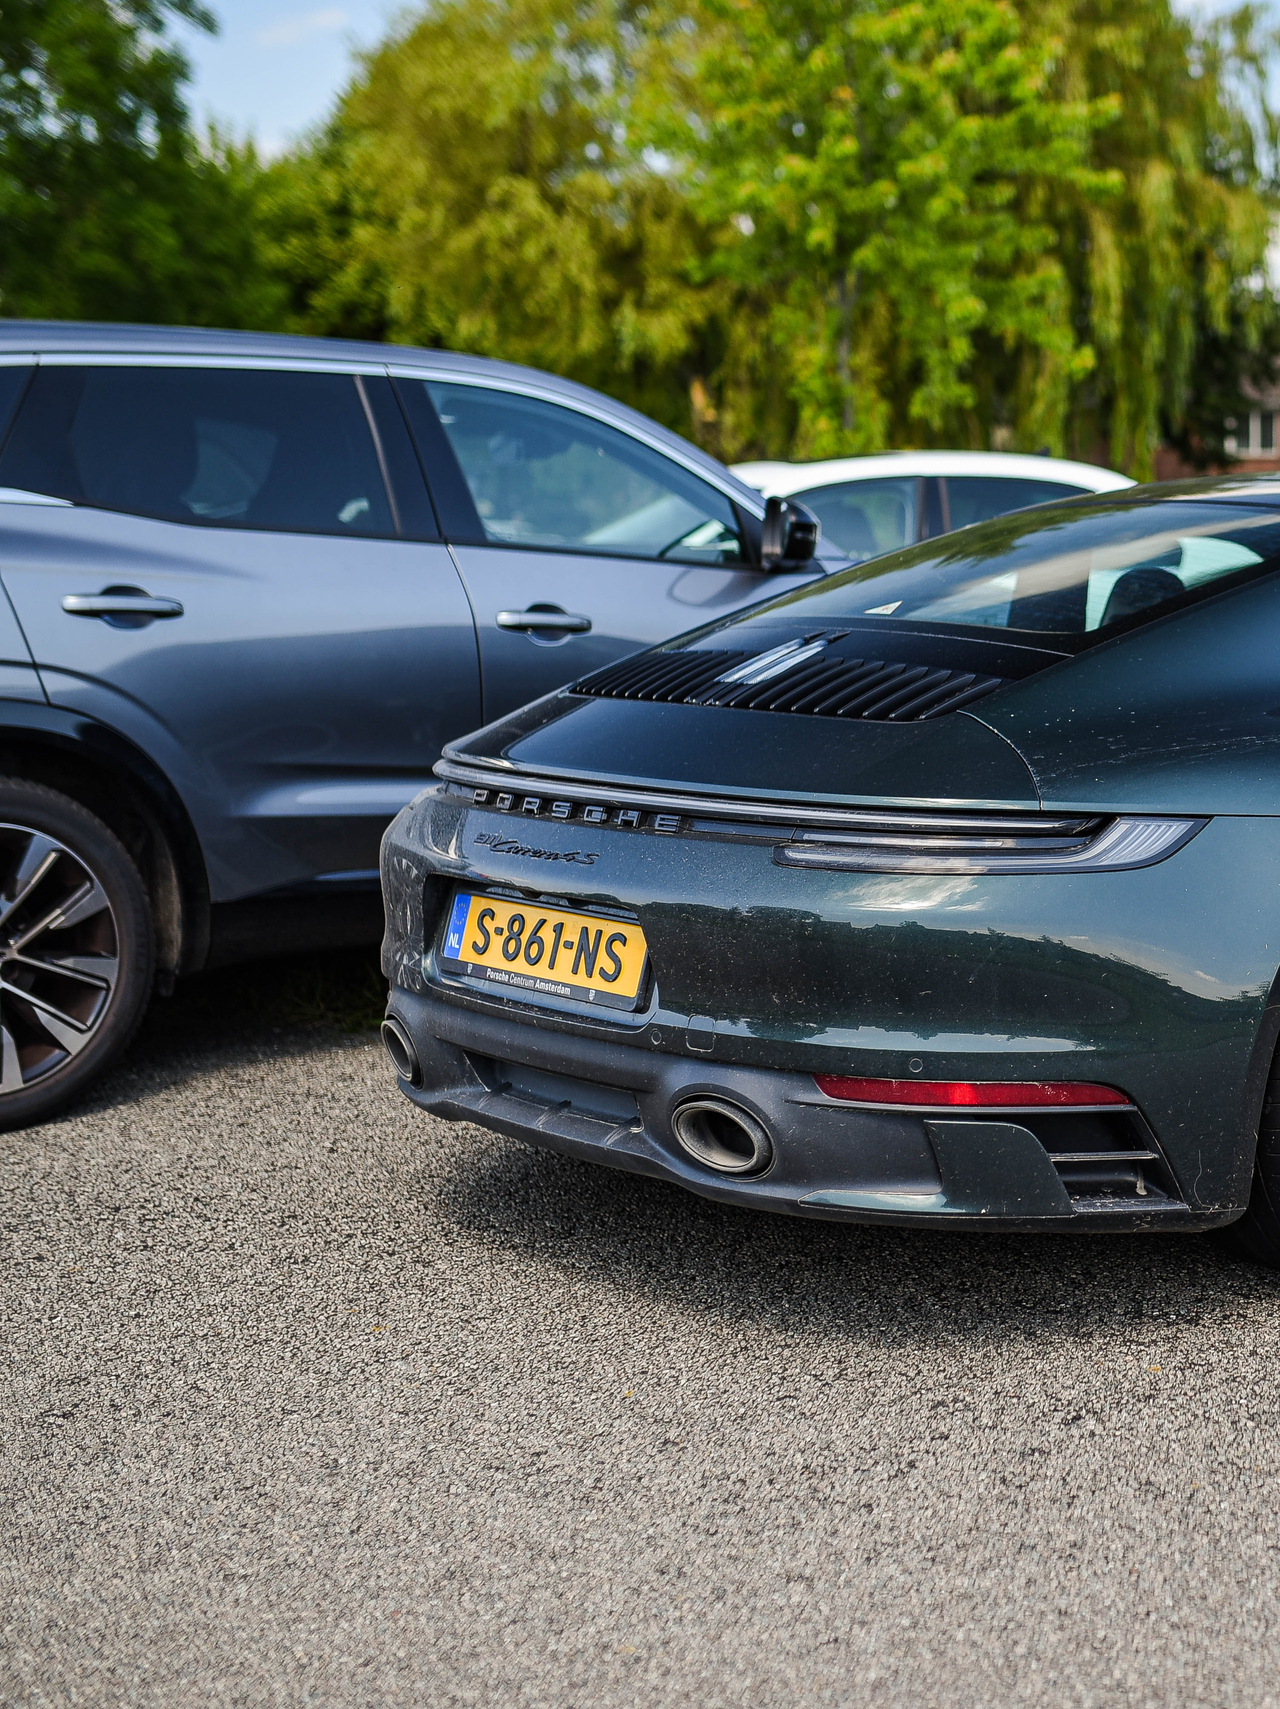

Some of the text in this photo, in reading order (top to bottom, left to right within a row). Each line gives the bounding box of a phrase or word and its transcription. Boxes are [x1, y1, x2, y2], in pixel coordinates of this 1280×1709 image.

[473, 789, 682, 833] PORSCHE
[473, 833, 503, 846] 911
[448, 932, 460, 949] NL
[471, 907, 628, 983] S-861-NS
[486, 968, 571, 996] Porsche Centrum Amsterdam
